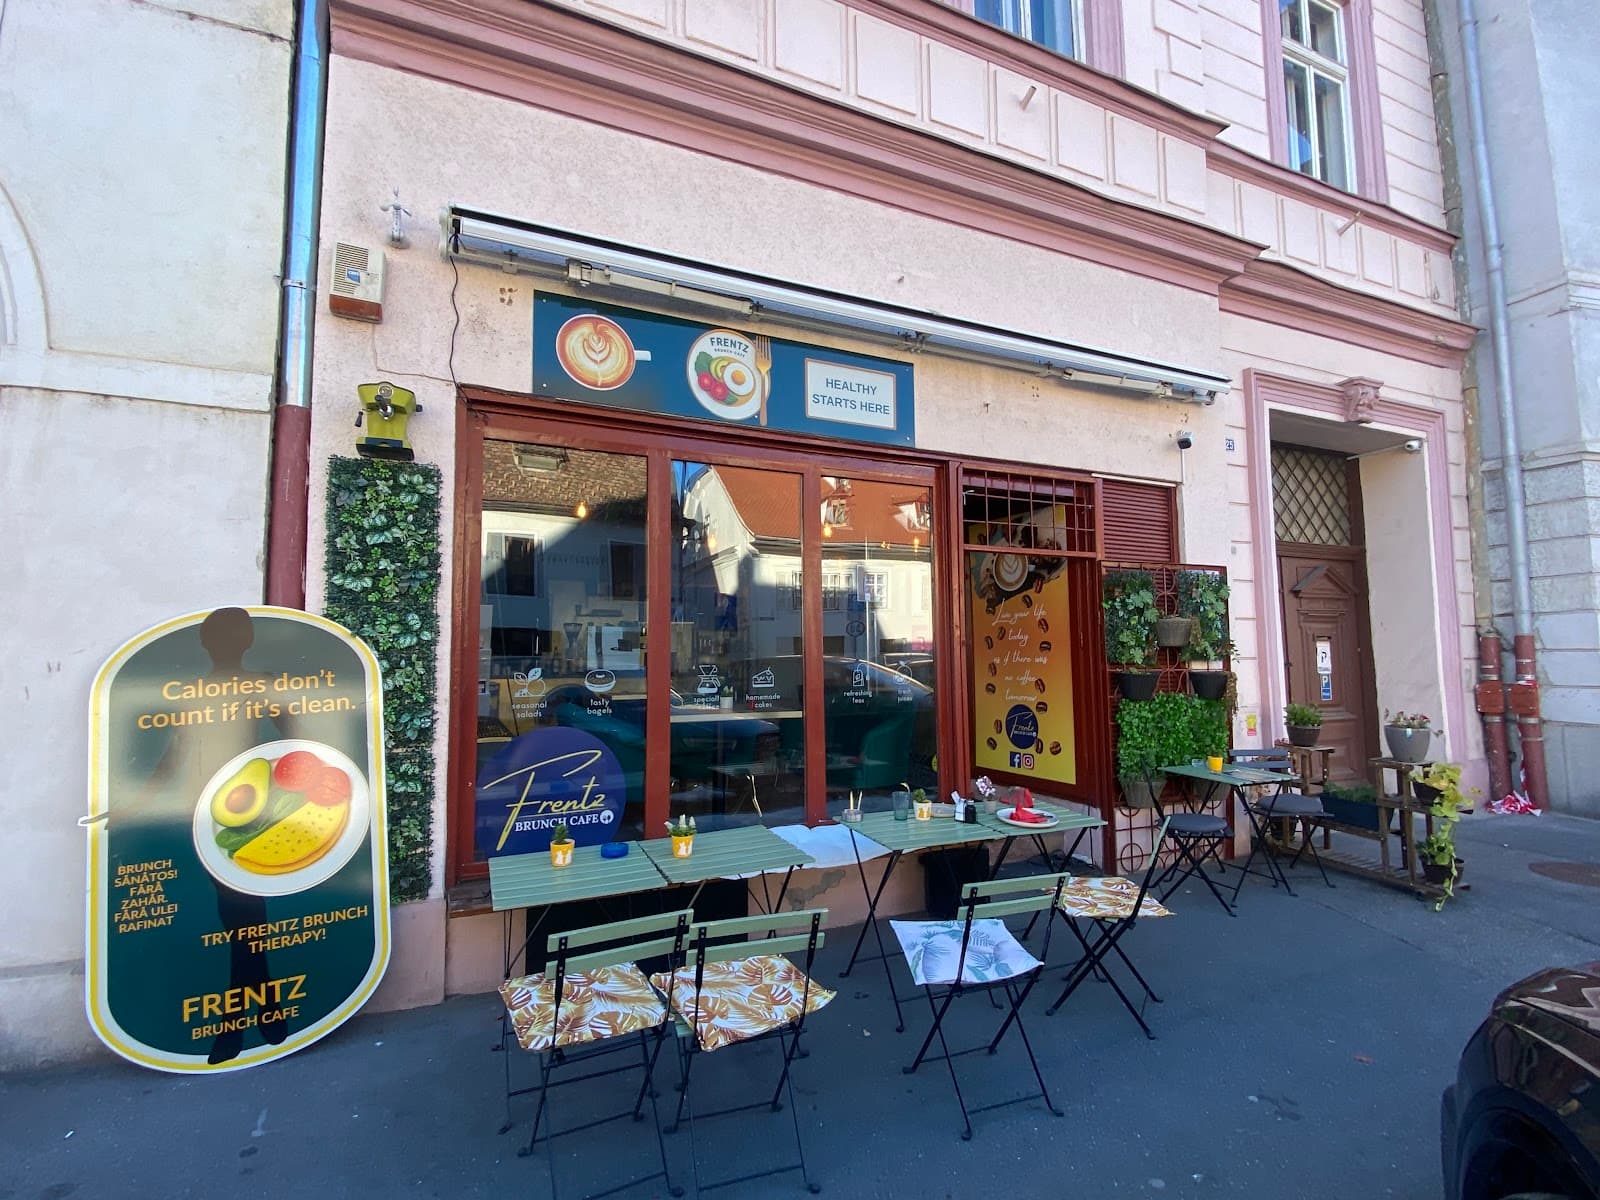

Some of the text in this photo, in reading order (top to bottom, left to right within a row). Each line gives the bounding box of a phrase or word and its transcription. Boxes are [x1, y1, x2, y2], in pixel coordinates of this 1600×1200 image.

[710, 336, 749, 353] FRENTZ
[825, 378, 877, 395] HEALTHY
[812, 393, 890, 415] STARTS HERE
[1008, 628, 1028, 646] today
[161, 669, 336, 700] Calories don't
[1322, 675, 1329, 688] P
[512, 701, 547, 709] seasonal
[590, 698, 610, 707] tasty
[745, 693, 780, 701] homemade
[754, 700, 772, 708] cakes
[137, 695, 356, 730] count if it's clean.
[516, 710, 542, 718] salads
[586, 707, 612, 717] bagels
[483, 749, 606, 852] Frentz
[515, 813, 599, 832] BRUNCH CAFE
[117, 859, 172, 876] BRUNCH
[130, 881, 164, 897] FĂRĂ
[114, 903, 178, 923] FĂRĂ ULEI
[119, 915, 174, 934] RAFINAT
[201, 905, 368, 947] TRY FRENTZ BRUNCH
[249, 928, 326, 954] THERAPY!
[182, 974, 307, 1023] FRENTZ
[192, 1005, 299, 1040] BRUNCH CAFE
